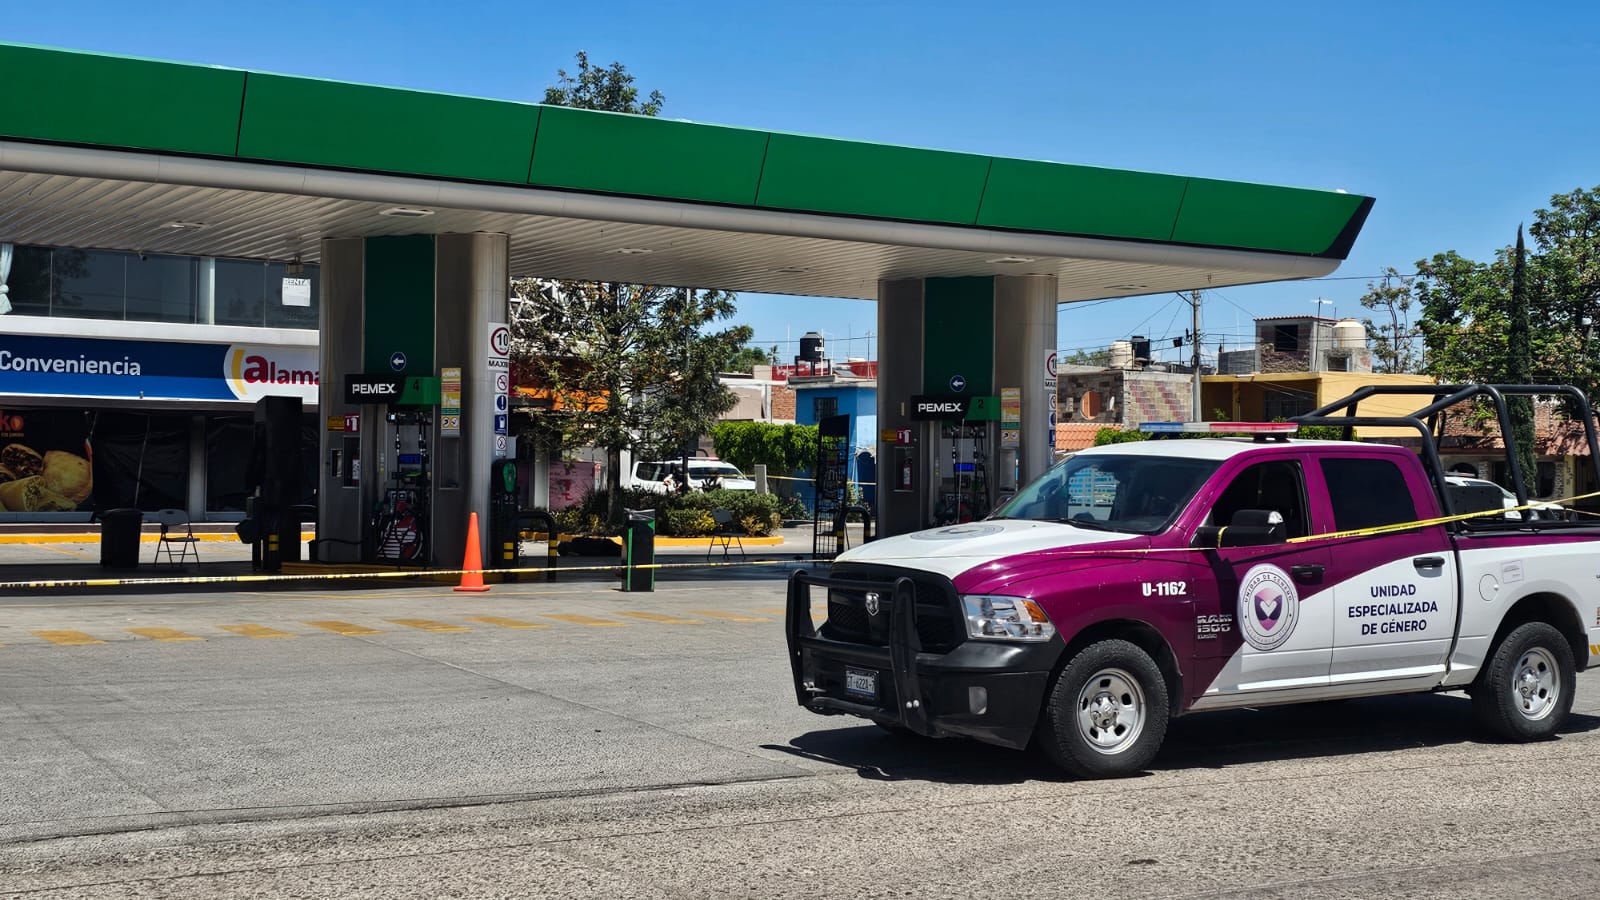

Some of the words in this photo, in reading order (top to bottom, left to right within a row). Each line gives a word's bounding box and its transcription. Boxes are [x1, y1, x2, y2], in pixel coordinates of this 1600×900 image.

[497, 333, 508, 346] 10
[0, 350, 141, 376] Conveniencia
[352, 383, 397, 395] PEMEX
[413, 379, 419, 392] 4
[917, 402, 964, 413] PEMEX
[978, 399, 984, 409] 2
[1142, 581, 1187, 597] U-1162
[1370, 584, 1416, 598] UNIDAD
[1348, 601, 1438, 618] ESPECIALIZADA
[1197, 614, 1232, 624] RAM
[1196, 623, 1231, 633] 1500
[1361, 623, 1378, 636] DE
[1380, 618, 1427, 634] GÉNERO
